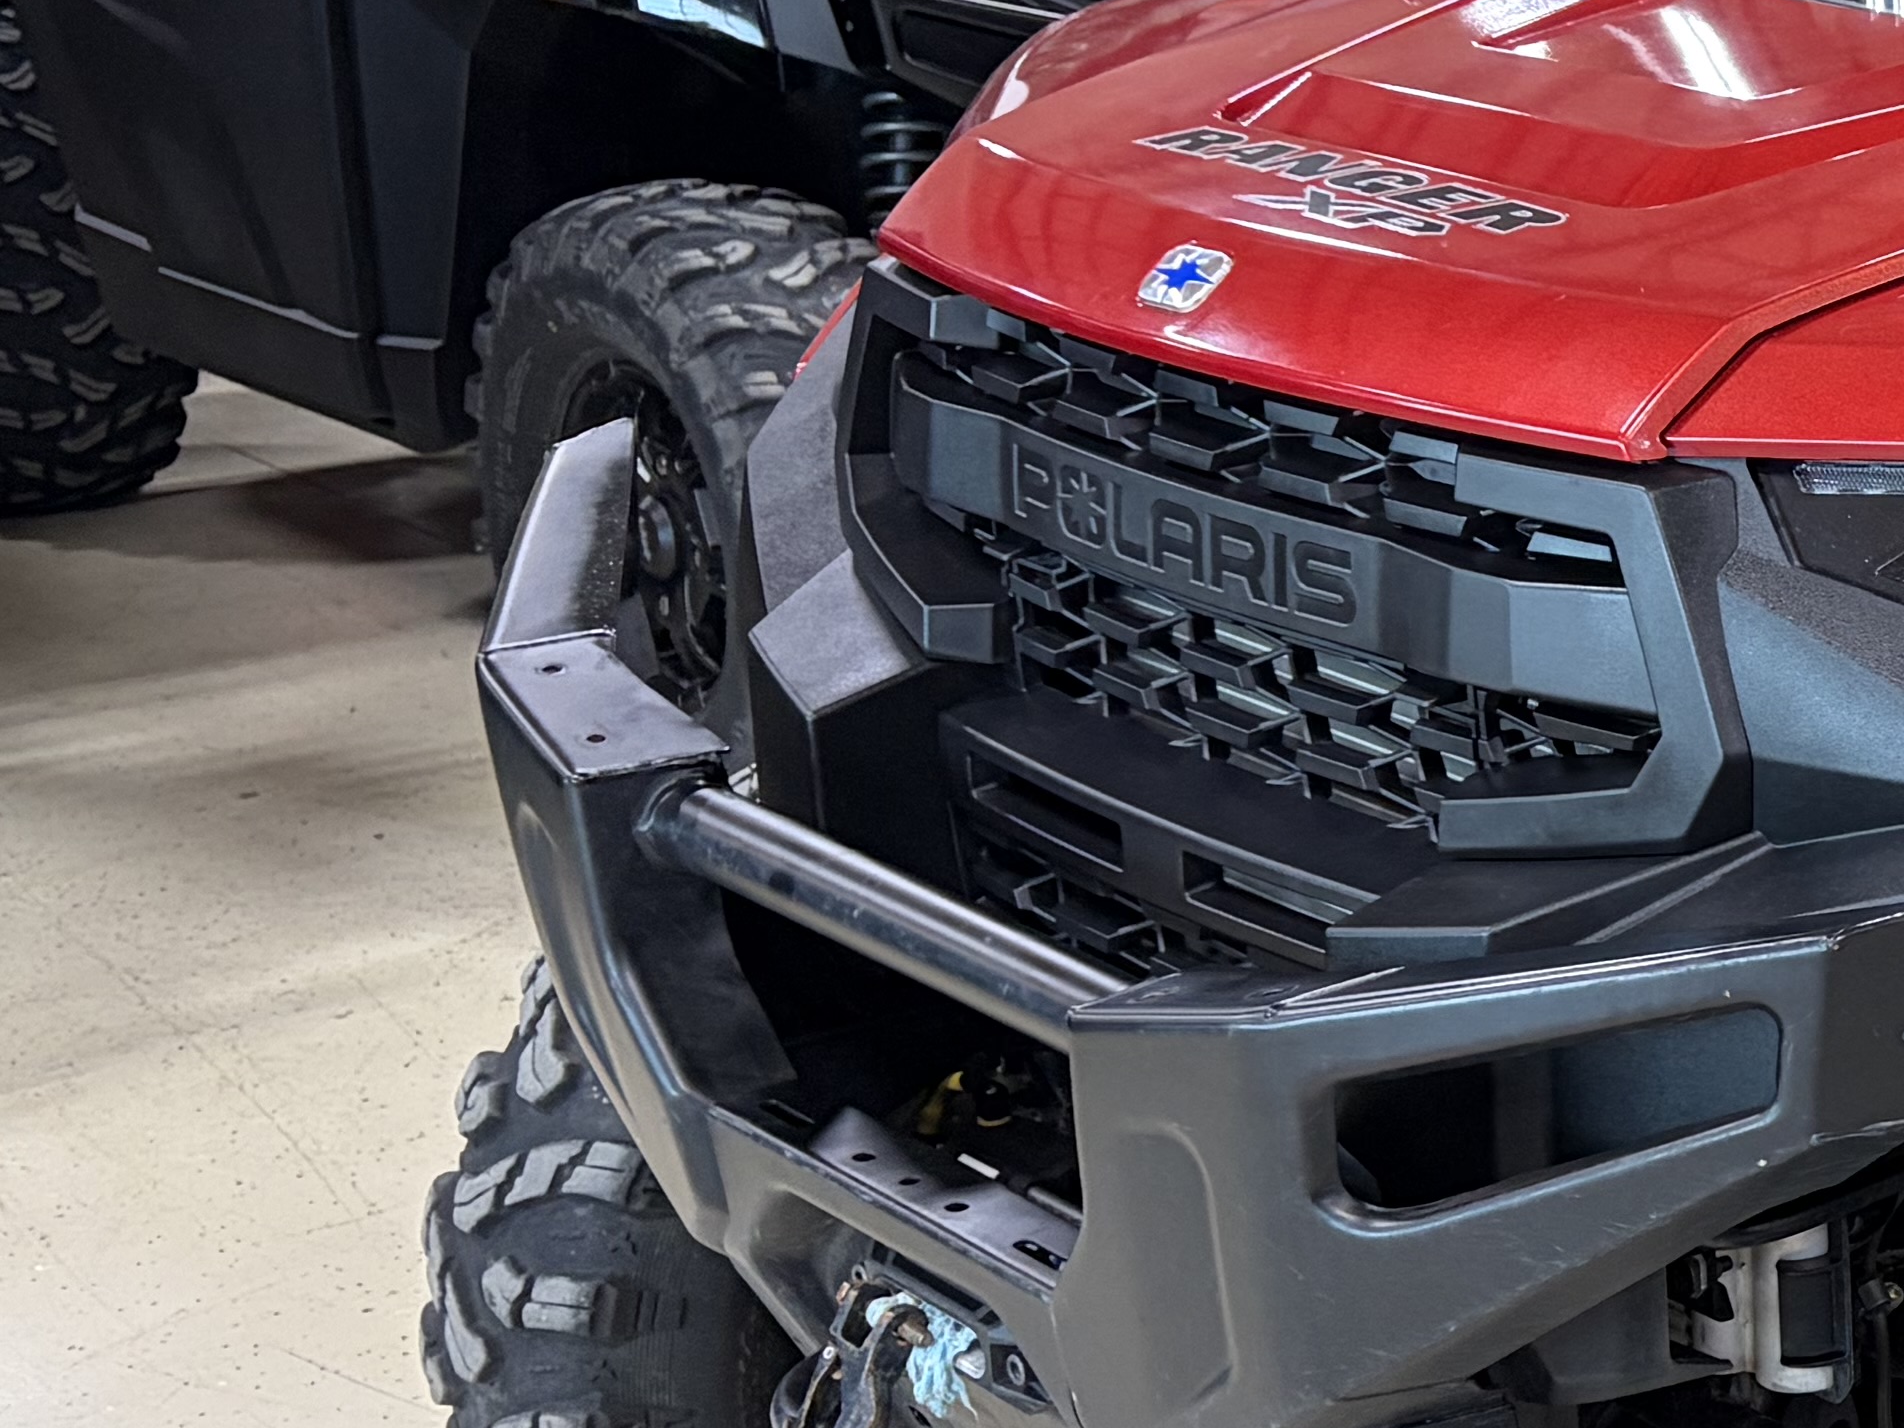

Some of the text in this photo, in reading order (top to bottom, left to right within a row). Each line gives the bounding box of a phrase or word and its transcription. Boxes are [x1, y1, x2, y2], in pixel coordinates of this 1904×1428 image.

[1133, 126, 1569, 235] RANGER
[1233, 185, 1451, 236] XP
[1012, 442, 1359, 628] POLARIS
